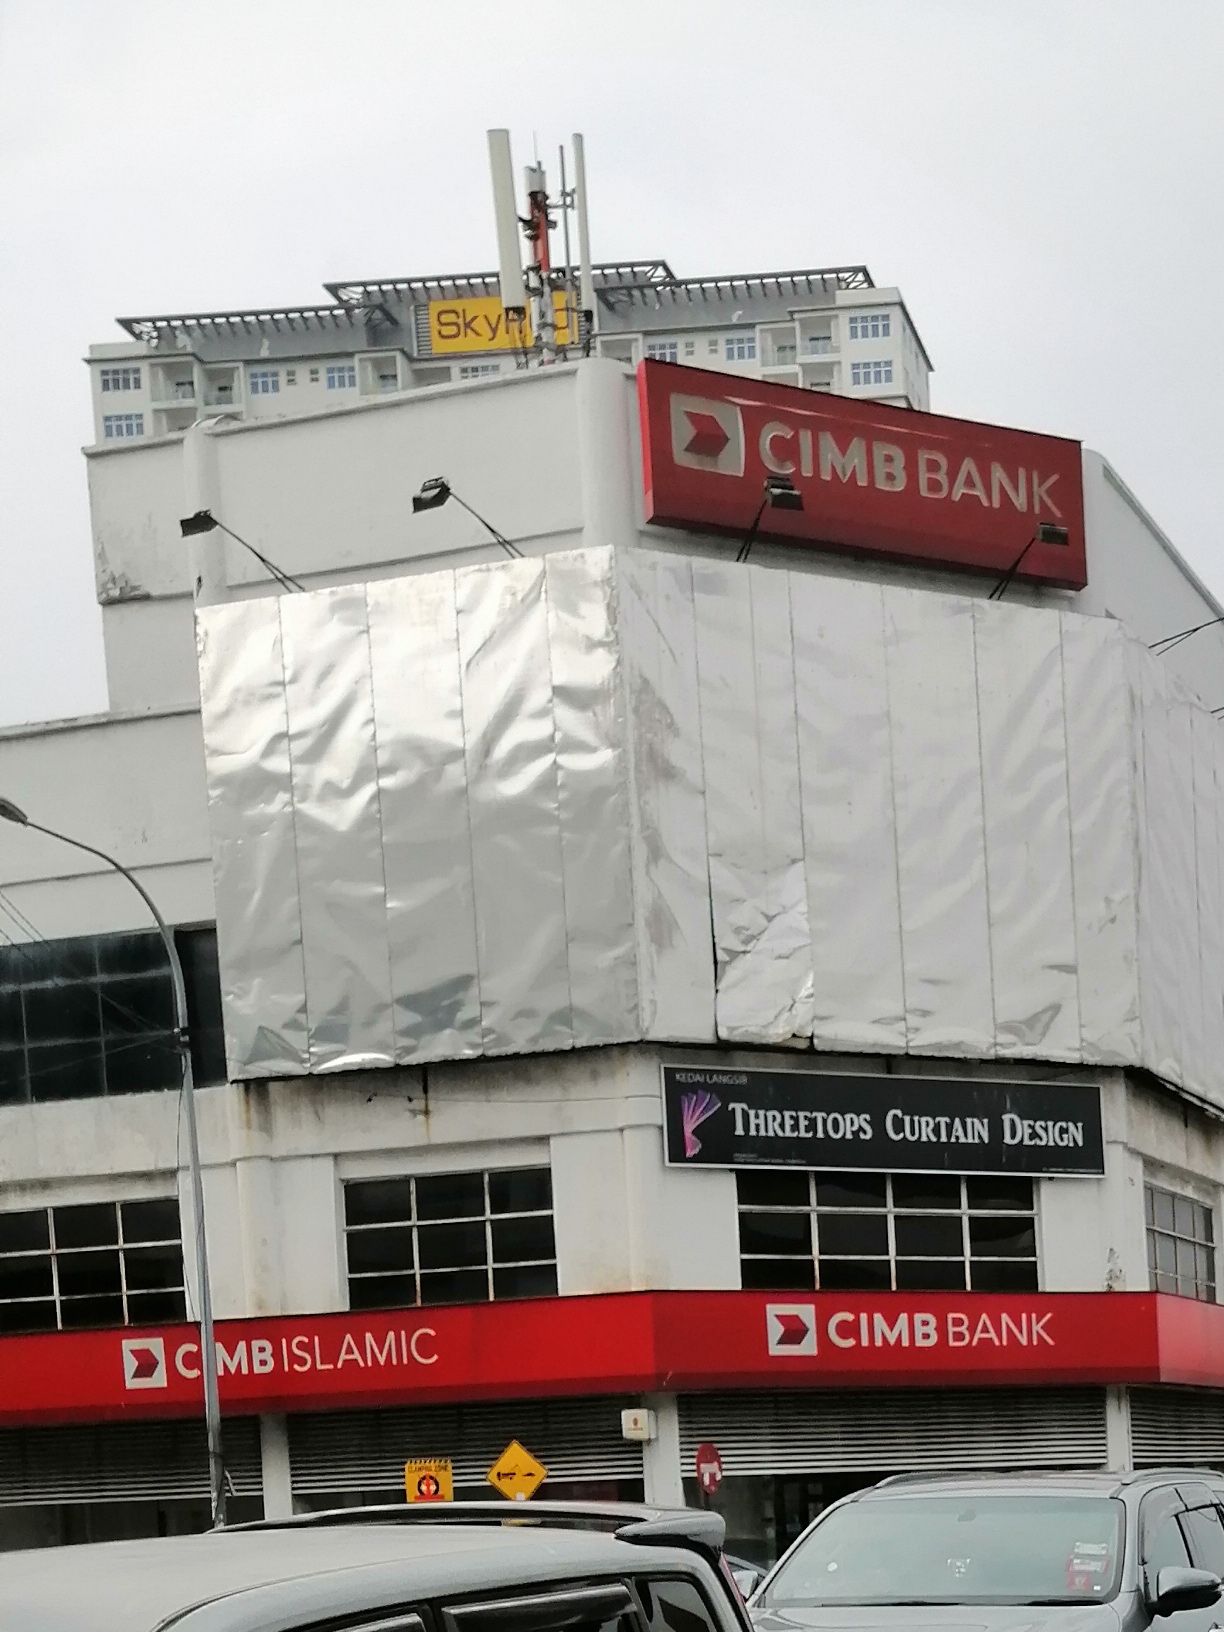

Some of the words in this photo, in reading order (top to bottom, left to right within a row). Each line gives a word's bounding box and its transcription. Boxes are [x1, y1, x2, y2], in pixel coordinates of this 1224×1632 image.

[758, 421, 908, 492] CIMB
[917, 447, 1062, 518] BANK
[675, 1071, 704, 1083] KEDAI
[728, 1102, 873, 1140] THREETOPS
[885, 1109, 989, 1144] CURTAIN
[1002, 1113, 1084, 1147] DESIGN
[827, 1311, 938, 1348] CIMB
[947, 1312, 1055, 1347] BANK
[175, 1339, 274, 1379] CMB
[281, 1327, 438, 1373] ISLAMIC
